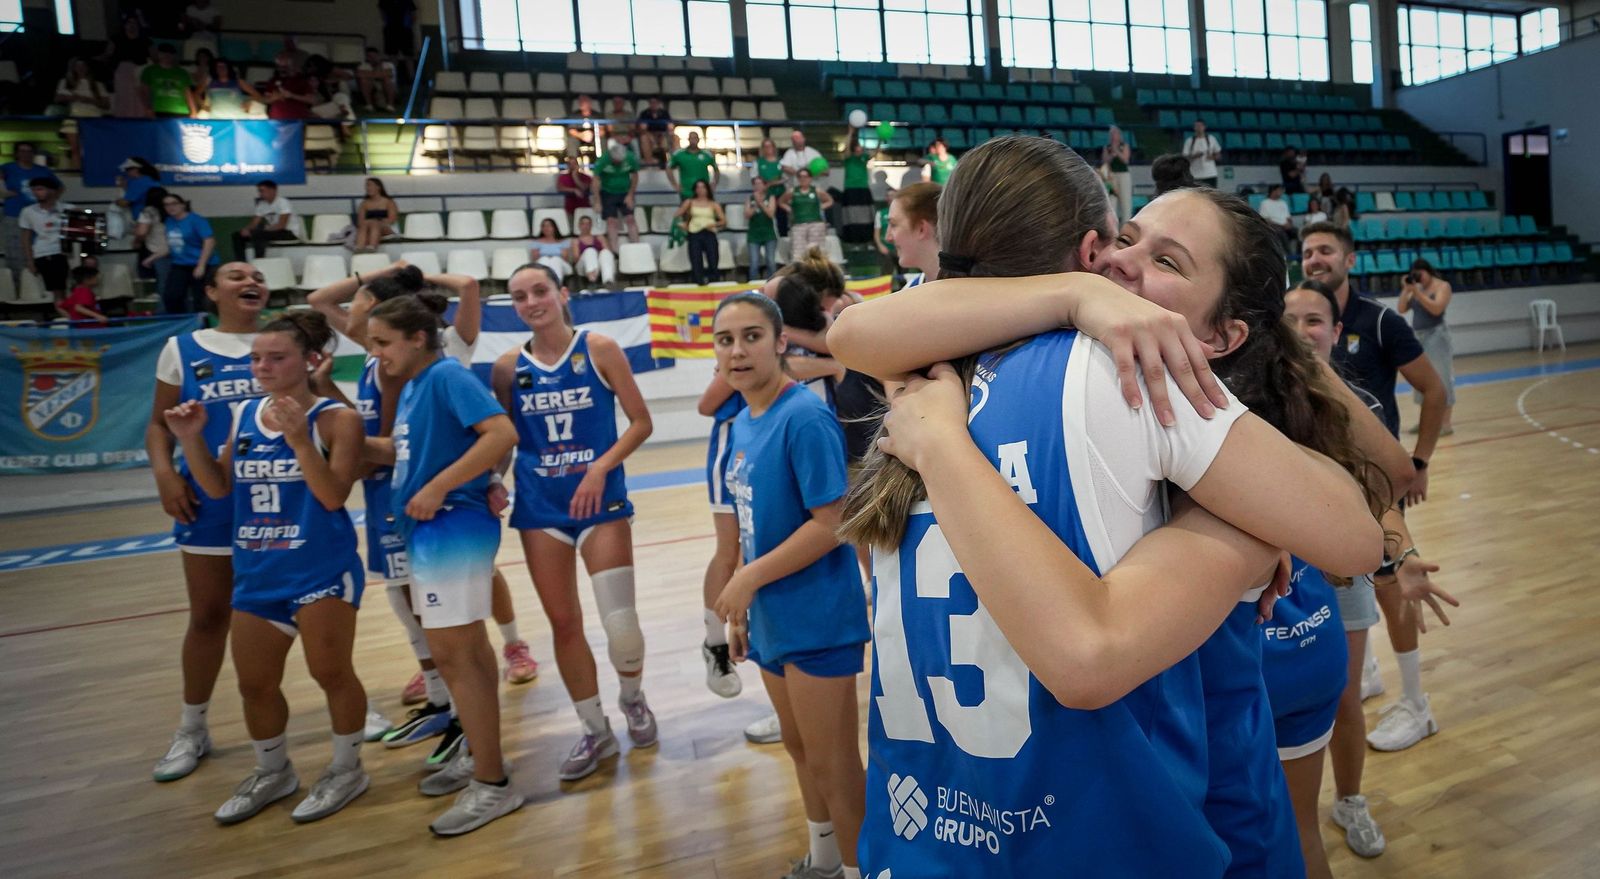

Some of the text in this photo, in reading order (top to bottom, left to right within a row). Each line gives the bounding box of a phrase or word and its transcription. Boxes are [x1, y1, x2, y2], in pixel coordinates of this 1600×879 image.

[200, 378, 264, 400] XERE
[520, 386, 593, 412] XEREZ
[544, 412, 573, 442] 17
[53, 453, 98, 467] CLUB
[250, 484, 281, 513] 21
[238, 525, 300, 540] DESAFIO
[872, 525, 1032, 759] 13
[1300, 634, 1317, 648] GYM
[934, 816, 1000, 855] GRUPO
